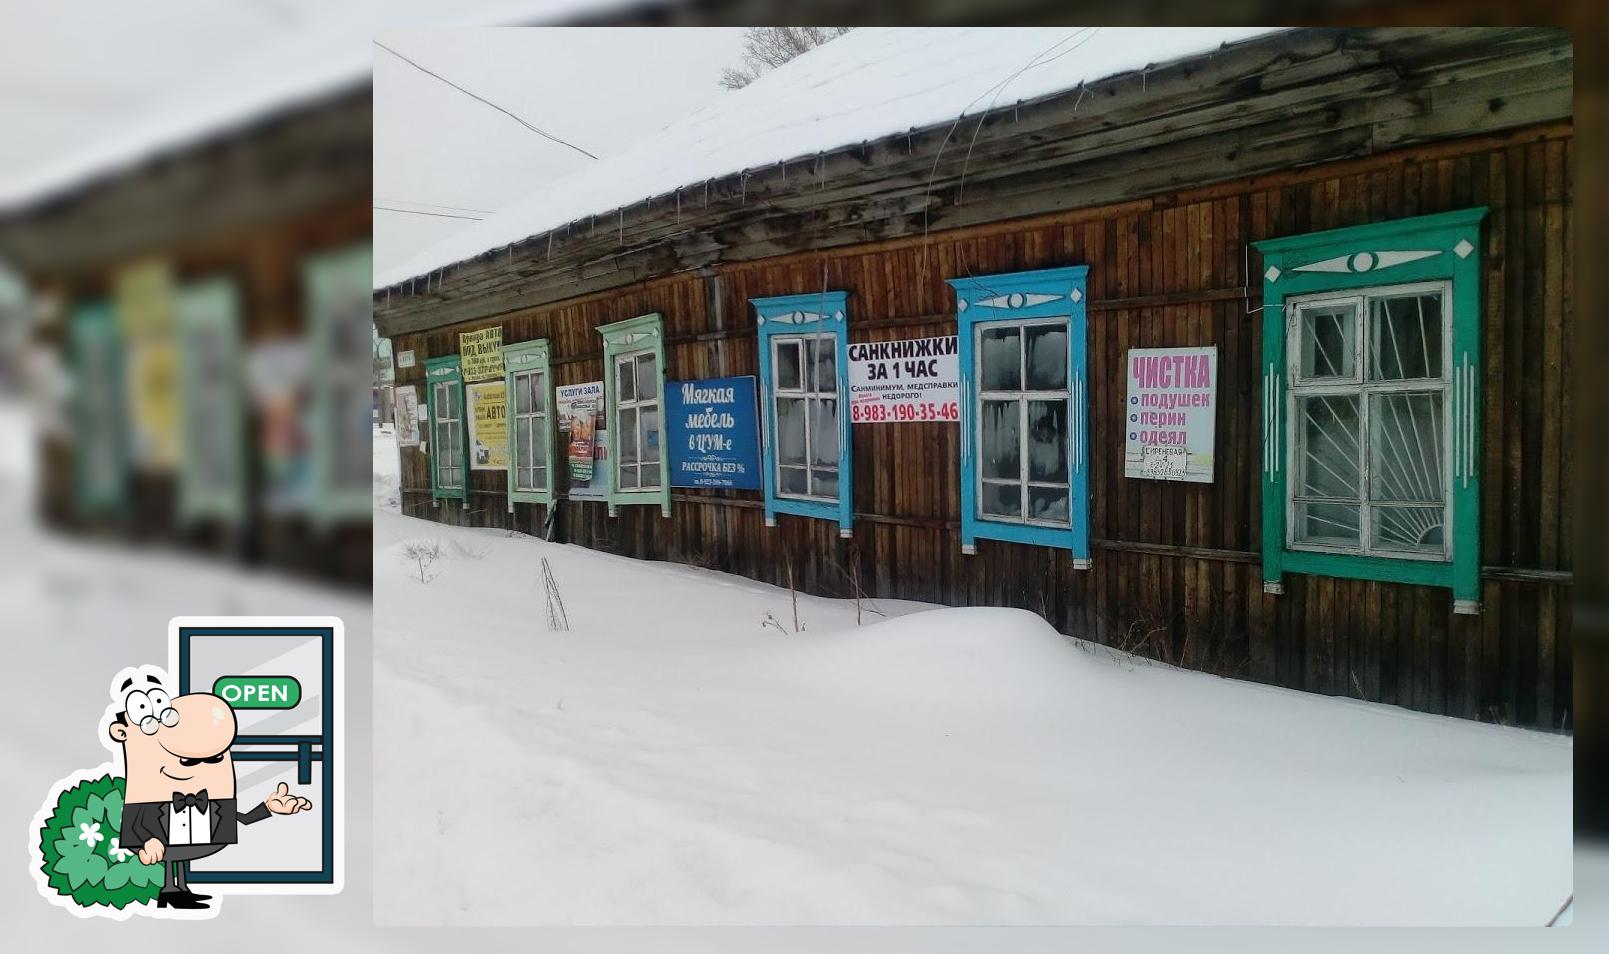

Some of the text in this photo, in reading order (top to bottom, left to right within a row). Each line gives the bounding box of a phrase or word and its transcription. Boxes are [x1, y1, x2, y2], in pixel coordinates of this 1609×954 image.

[485, 328, 502, 339] АВТО
[849, 337, 958, 361] САНКНИЖКИ
[868, 359, 938, 380] ЗА 1 ЧАС
[1132, 355, 1210, 388] ЧИСТКА
[560, 385, 600, 398] УСЛУГИ ЗАЛА
[682, 383, 735, 404] Мягкая
[907, 381, 958, 391] МЕДСПРАВКИ
[882, 392, 922, 400] НЕДОРОГО!
[1141, 393, 1210, 409] подушек
[487, 405, 506, 420] АВТО
[685, 407, 735, 429] мебель
[852, 402, 958, 421] 8-983-190-35-46
[1140, 412, 1186, 428] перин
[688, 433, 732, 453] в ЦУМ-е
[1140, 430, 1187, 446] одеял
[682, 462, 721, 472] РАССРОЧКА
[722, 463, 736, 472] БЕЗ
